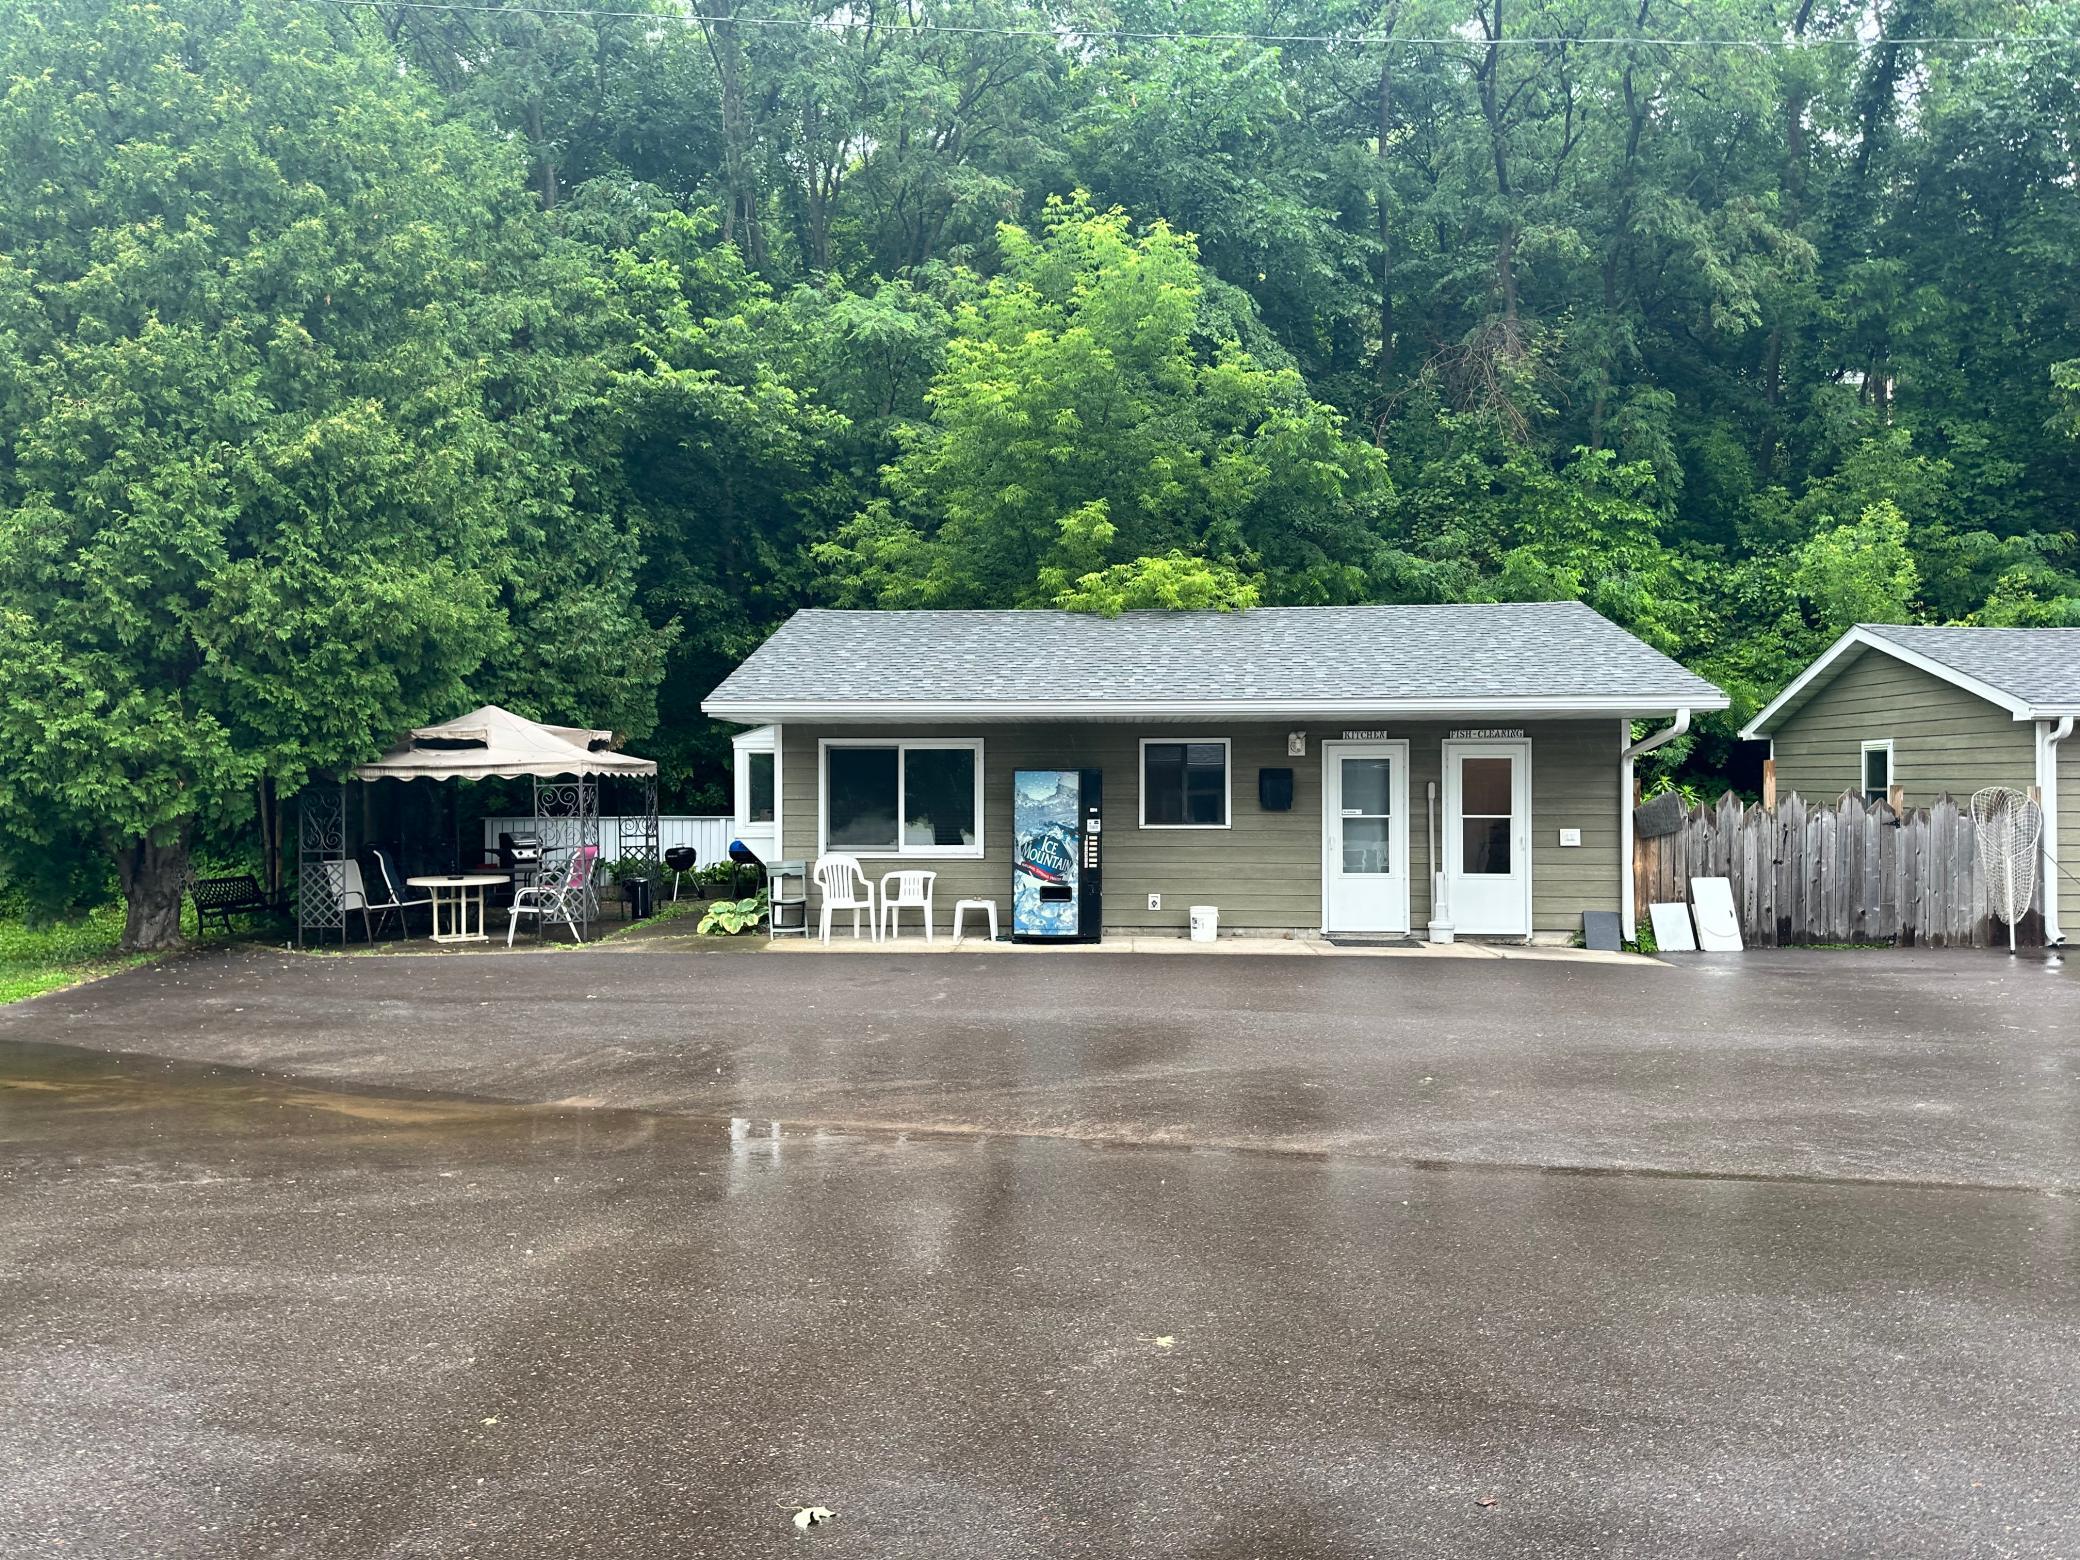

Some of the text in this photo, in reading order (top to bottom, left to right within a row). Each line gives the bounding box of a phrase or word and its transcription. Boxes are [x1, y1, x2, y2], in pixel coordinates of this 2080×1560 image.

[1343, 731, 1387, 740] KITCHEN
[1041, 836, 1059, 855] ICE
[1021, 841, 1072, 871] MOUNTAIN
